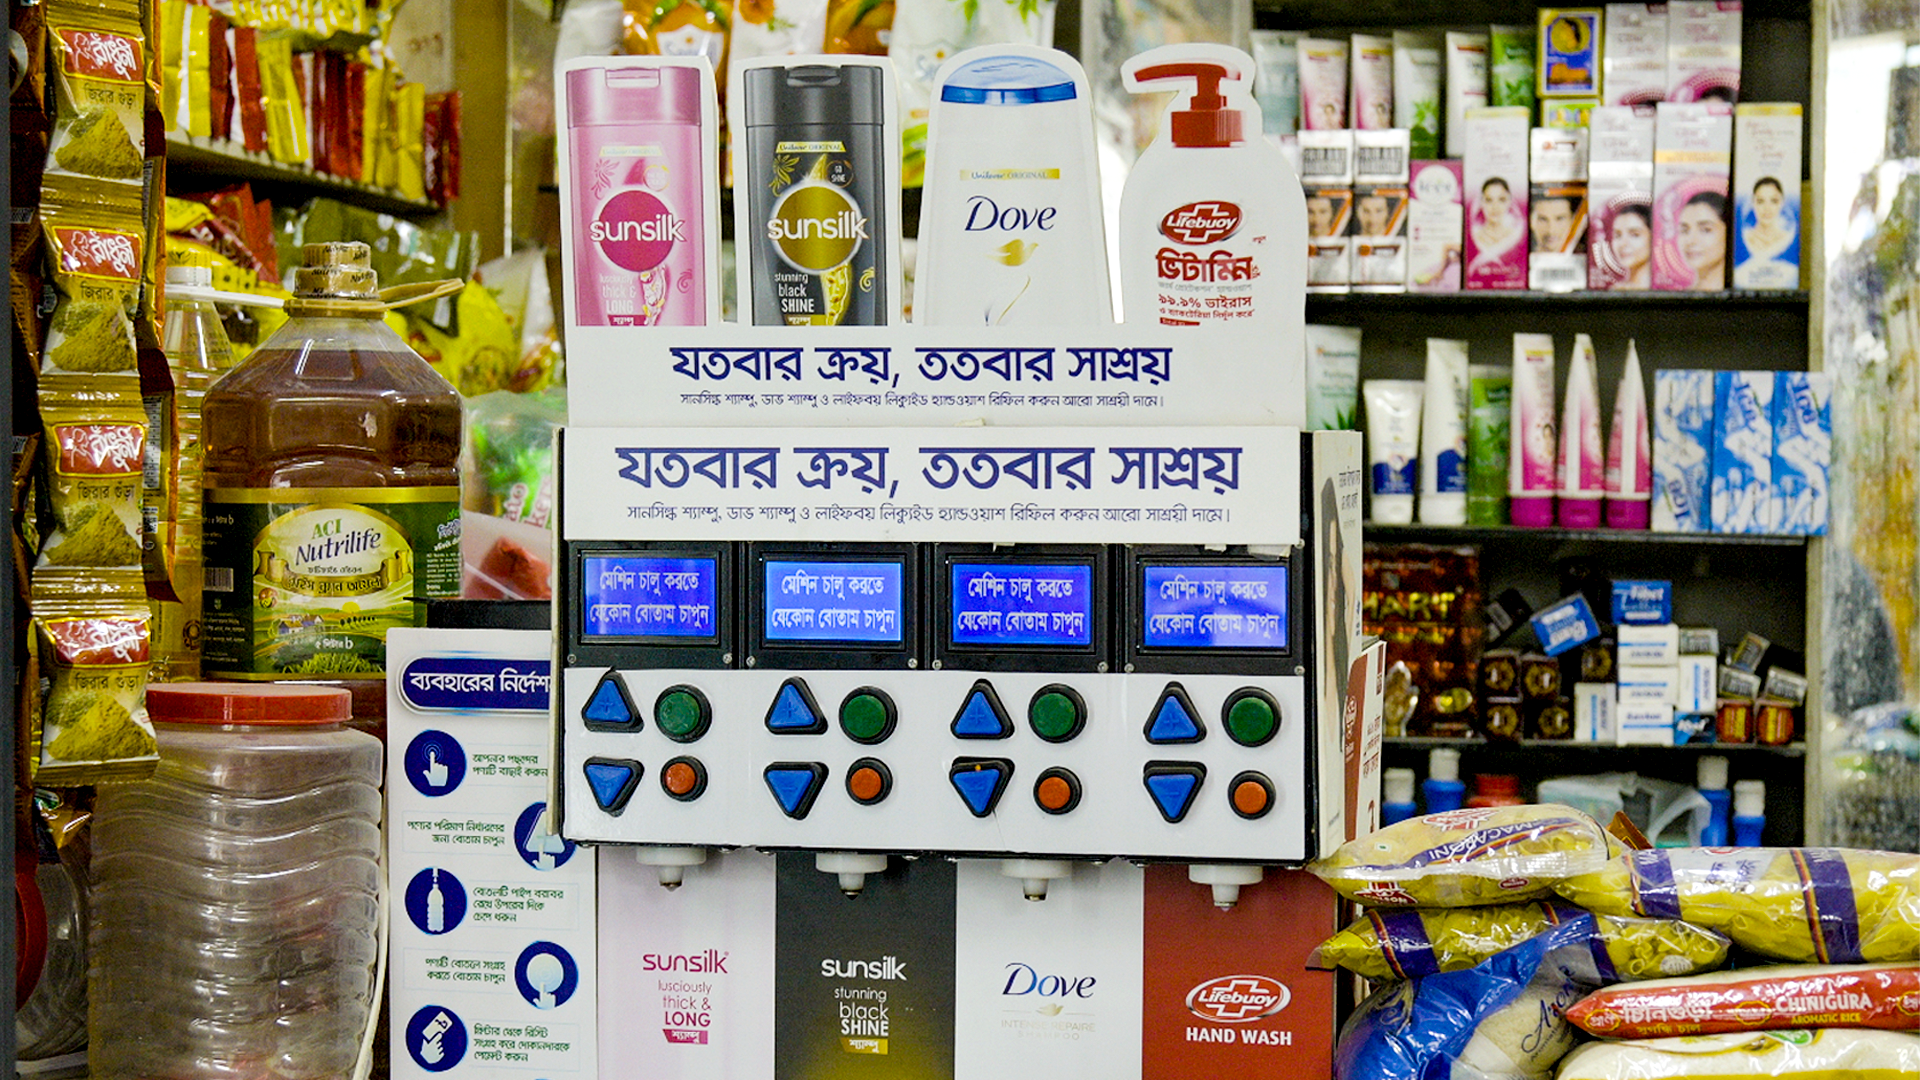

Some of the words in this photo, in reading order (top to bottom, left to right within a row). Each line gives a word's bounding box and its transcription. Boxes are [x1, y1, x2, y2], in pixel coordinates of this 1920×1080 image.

[767, 210, 870, 240] sunsilk
[965, 195, 1057, 231] Dove
[1166, 214, 1239, 231] Lifebuoy
[589, 213, 687, 243] sunsilk
[778, 283, 807, 297] black
[1204, 294, 1253, 309] ভাইরাস
[781, 298, 815, 313] SHINE
[669, 347, 804, 381] যতবার
[814, 347, 900, 388] ক্রয়,
[915, 347, 1056, 382] ততবার
[1066, 347, 1173, 386] সাশ্রয়
[761, 392, 785, 406] ডাভ
[820, 394, 829, 406] ও
[1028, 394, 1061, 407] করুন
[615, 447, 781, 489] যতবার
[793, 447, 900, 498] ক্রয়,
[919, 447, 1096, 490] ততবার
[1109, 447, 1243, 496] সাশ্রয়
[726, 504, 755, 521] ডাভ
[799, 508, 810, 521] ও
[814, 503, 876, 521] লাইফবয়
[1010, 503, 1056, 522] রিফিল
[1059, 507, 1100, 522] করুন
[1102, 505, 1141, 522] আরো
[1145, 503, 1188, 524] সাশ্রয়ী
[312, 518, 342, 540] ACI
[296, 528, 382, 567] Nutrilife
[600, 566, 635, 591] মেশিন
[639, 571, 661, 596] চালু
[664, 570, 699, 590] করতে
[781, 569, 819, 596] মেশিন
[822, 574, 846, 600] চালু
[848, 575, 885, 596] করতে
[968, 571, 1005, 597] মেশিন
[1009, 576, 1034, 603] চালু
[1036, 578, 1074, 598] করতে
[1160, 574, 1199, 600] মেশিন
[1202, 577, 1228, 605] চালু
[1229, 579, 1269, 600] করতে
[590, 603, 632, 624] যেকোন
[635, 603, 675, 624] বোতাম
[678, 603, 711, 629] চাপুন
[772, 607, 814, 629] যেকোন
[818, 607, 859, 630] বোতাম
[863, 608, 895, 634] চাপুন
[958, 610, 1002, 632] যেকোন
[1005, 611, 1049, 632] বোতাম
[1052, 611, 1085, 638] চাপুন
[1150, 613, 1195, 635] যেকোন
[1199, 614, 1242, 635] বোতাম
[1246, 614, 1279, 640] চাপুন
[409, 671, 495, 693] ব্যবহারের
[499, 667, 550, 693] নির্দেশ
[642, 949, 728, 974] sunsilk
[821, 955, 908, 981] sunsilk
[658, 979, 713, 995] lusciously
[1002, 962, 1097, 999] Dove
[662, 995, 697, 1010] thick
[701, 996, 712, 1011] &
[834, 986, 888, 1003] stunning
[1197, 990, 1280, 1007] Lifebuoy
[1774, 992, 1873, 1013] CHINIGURA
[664, 1011, 711, 1028] LONG
[839, 1002, 889, 1020] black
[1791, 1013, 1838, 1025] AROMATIC
[1839, 1012, 1861, 1023] RICE
[841, 1019, 889, 1037] SHINE
[1185, 1026, 1236, 1044] HAND
[1240, 1028, 1292, 1046] WASH
